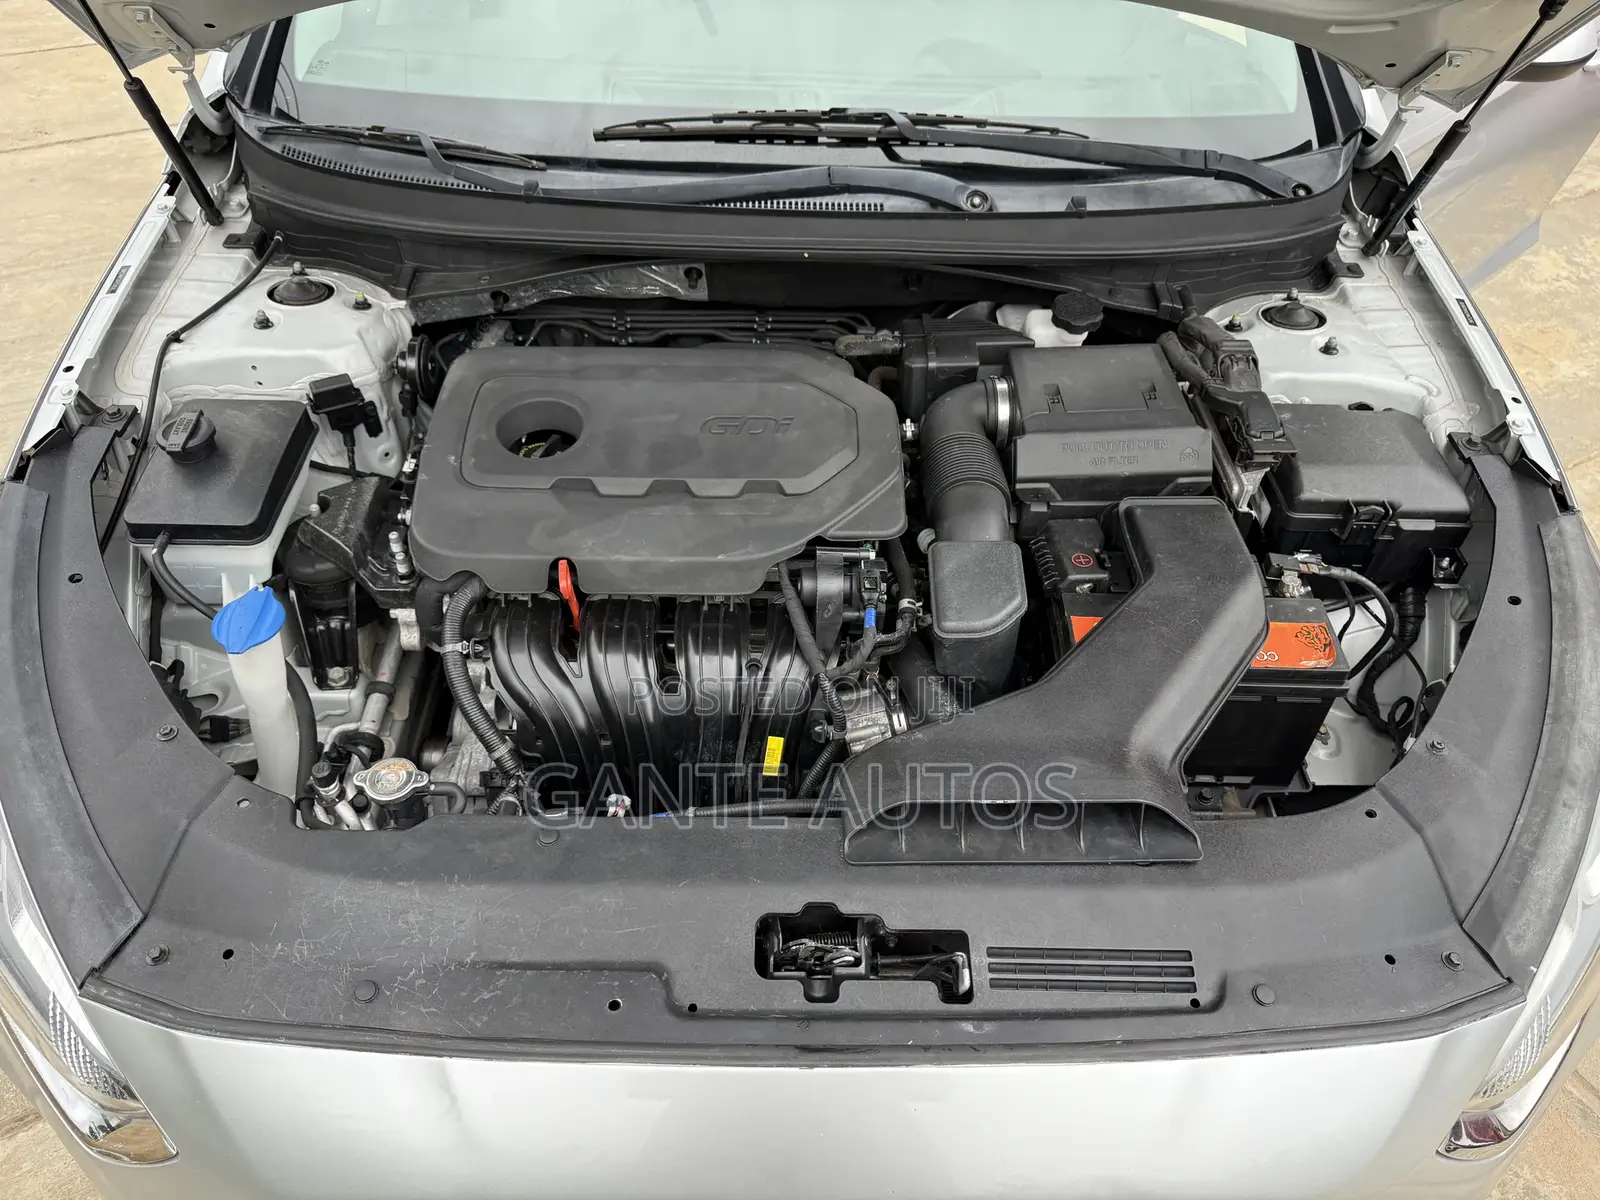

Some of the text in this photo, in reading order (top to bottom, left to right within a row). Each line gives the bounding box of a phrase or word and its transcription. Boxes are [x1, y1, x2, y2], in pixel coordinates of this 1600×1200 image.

[1060, 439, 1169, 453] PULL OUT TO OPEN
[1089, 455, 1139, 466] AIR FILTER
